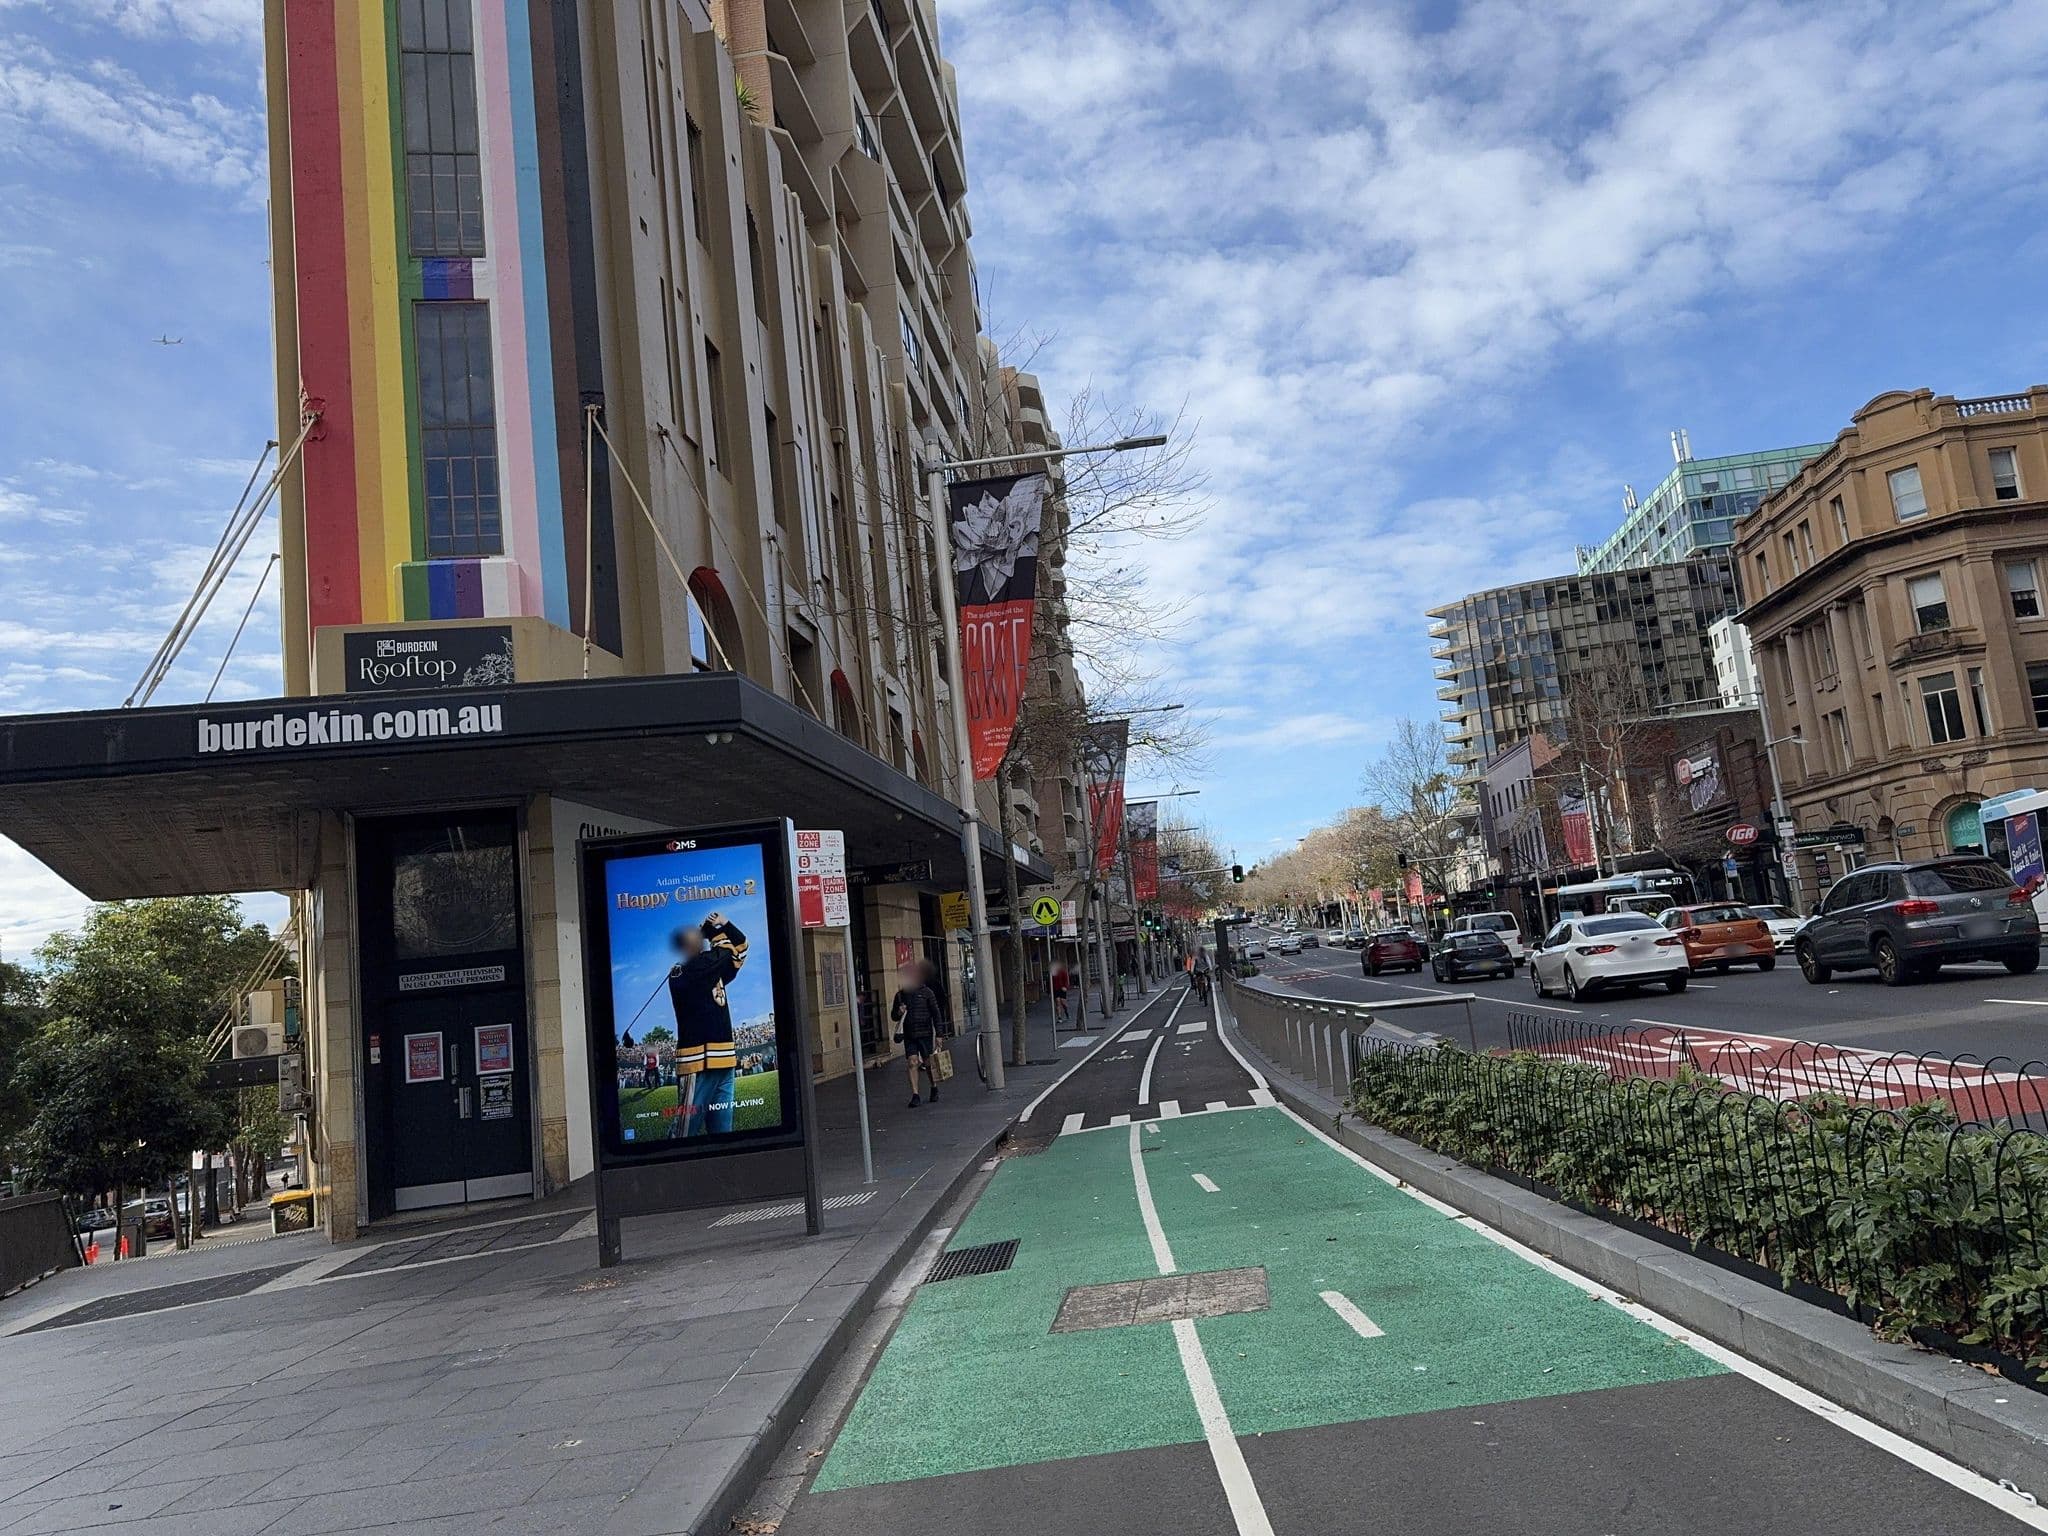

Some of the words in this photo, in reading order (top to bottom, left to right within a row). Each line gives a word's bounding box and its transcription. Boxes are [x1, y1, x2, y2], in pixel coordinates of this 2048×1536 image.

[397, 641, 438, 653] BURDEKIN
[360, 656, 457, 685] Rooftop
[198, 704, 502, 752] burdekin.com.au
[1731, 827, 1755, 840] IGA
[671, 840, 697, 851] QMS
[2011, 845, 2021, 861] Sell
[801, 857, 809, 868] B
[2014, 861, 2025, 874] fast
[656, 877, 680, 887] Adam
[682, 873, 716, 884] Sandler
[1671, 877, 1682, 885] 373
[616, 889, 669, 909] Happy
[674, 883, 740, 902] Gilmore
[744, 879, 757, 895] 2
[825, 886, 844, 894] ZONE
[401, 974, 430, 983] CLOSED
[431, 971, 460, 980] CIRCUIT
[462, 966, 503, 977] TELEVISION
[414, 981, 427, 989] USE
[429, 979, 440, 987] ON
[443, 977, 464, 986] THESE
[466, 974, 501, 984] PREMISES
[708, 1103, 728, 1111] NOW
[731, 1098, 764, 1109] PLAYING
